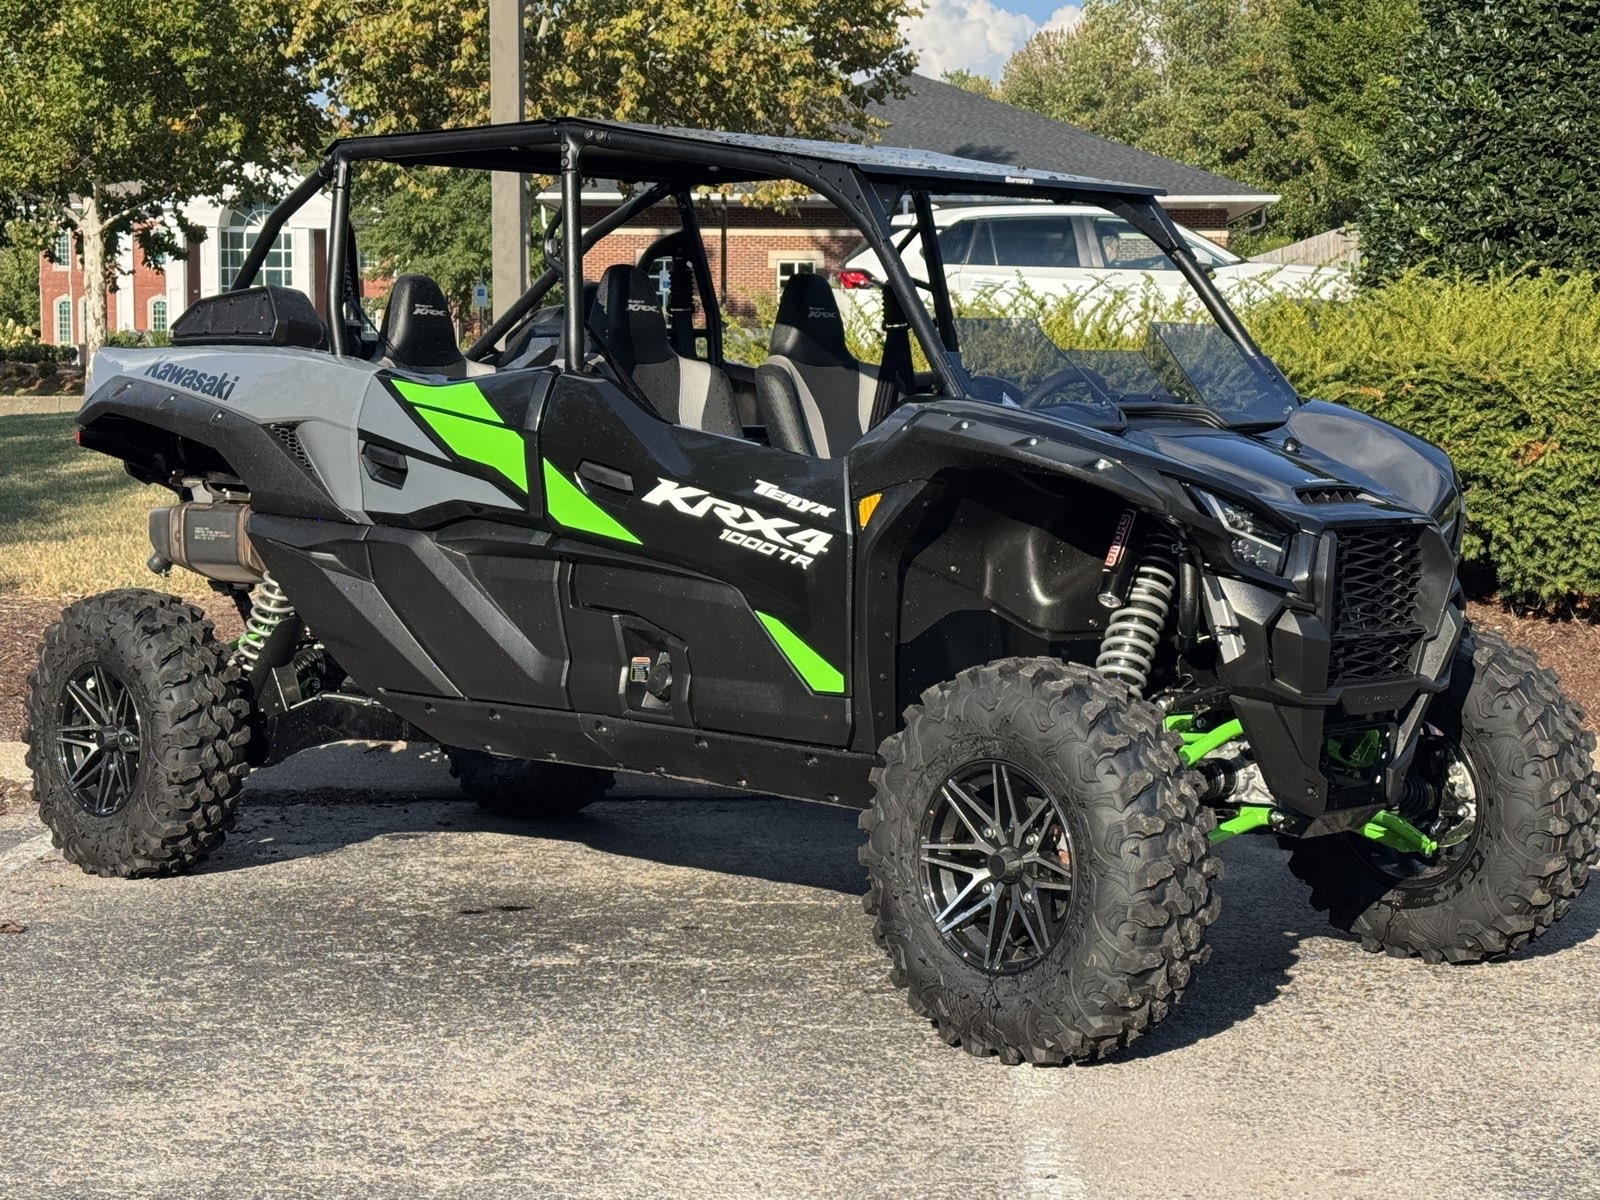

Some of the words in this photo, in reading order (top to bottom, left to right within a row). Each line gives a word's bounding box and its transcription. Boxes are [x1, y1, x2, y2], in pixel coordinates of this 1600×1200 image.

[144, 356, 240, 402] Kawasaki
[641, 476, 834, 556] KRX4
[718, 527, 814, 570] 1000TR
